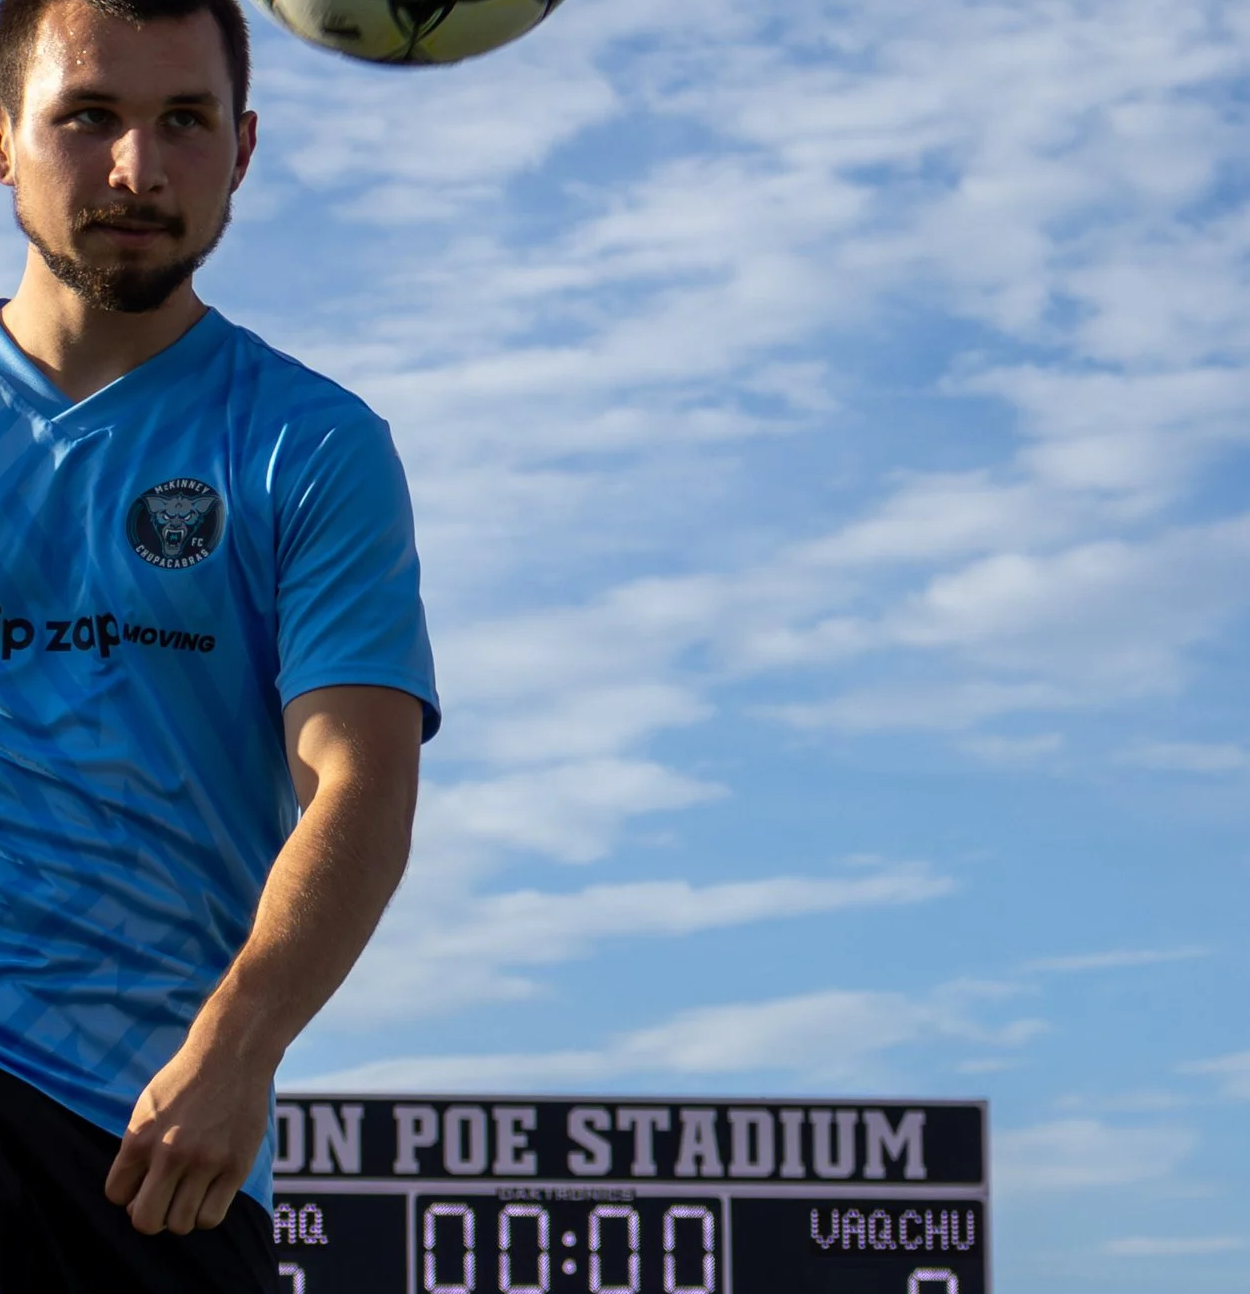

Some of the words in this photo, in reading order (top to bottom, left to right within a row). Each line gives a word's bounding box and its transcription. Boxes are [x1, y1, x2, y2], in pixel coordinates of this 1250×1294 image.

[135, 545, 210, 569] CHUPACABRAS
[191, 537, 204, 548] FC
[45, 611, 121, 658] zap
[122, 622, 217, 654] MOVING
[393, 1104, 538, 1177] POE
[567, 1107, 927, 1180] STADIUM
[810, 1209, 975, 1250] VAQCHU
